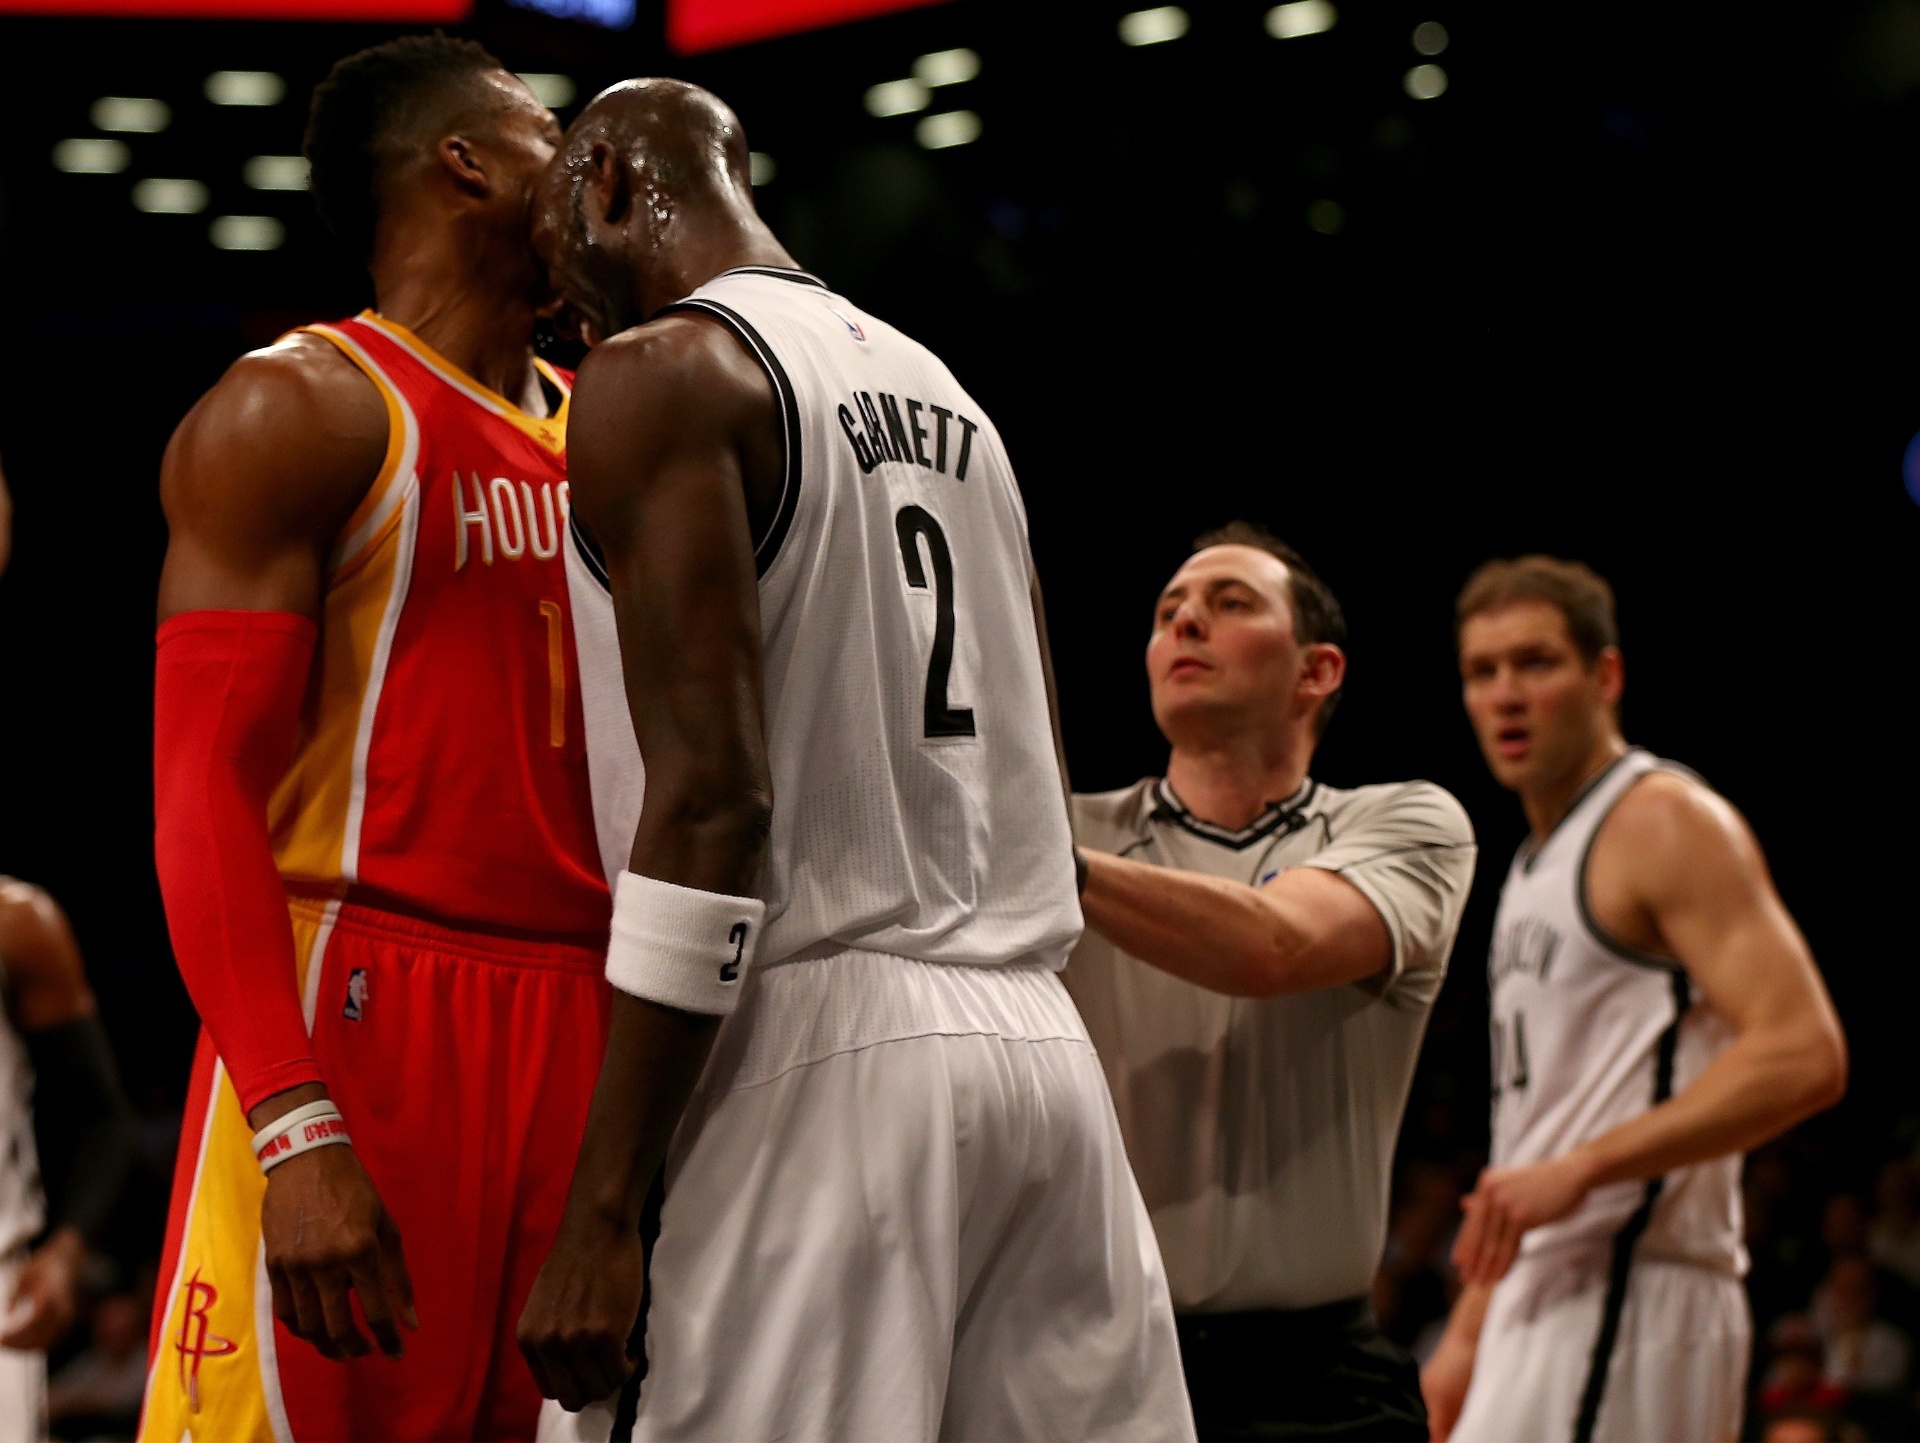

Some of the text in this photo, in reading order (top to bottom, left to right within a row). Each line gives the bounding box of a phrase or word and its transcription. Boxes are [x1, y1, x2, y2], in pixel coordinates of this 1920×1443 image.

[838, 391, 978, 482] GARNETT
[539, 599, 566, 748] 1
[895, 504, 976, 738] 2
[719, 921, 748, 982] 2
